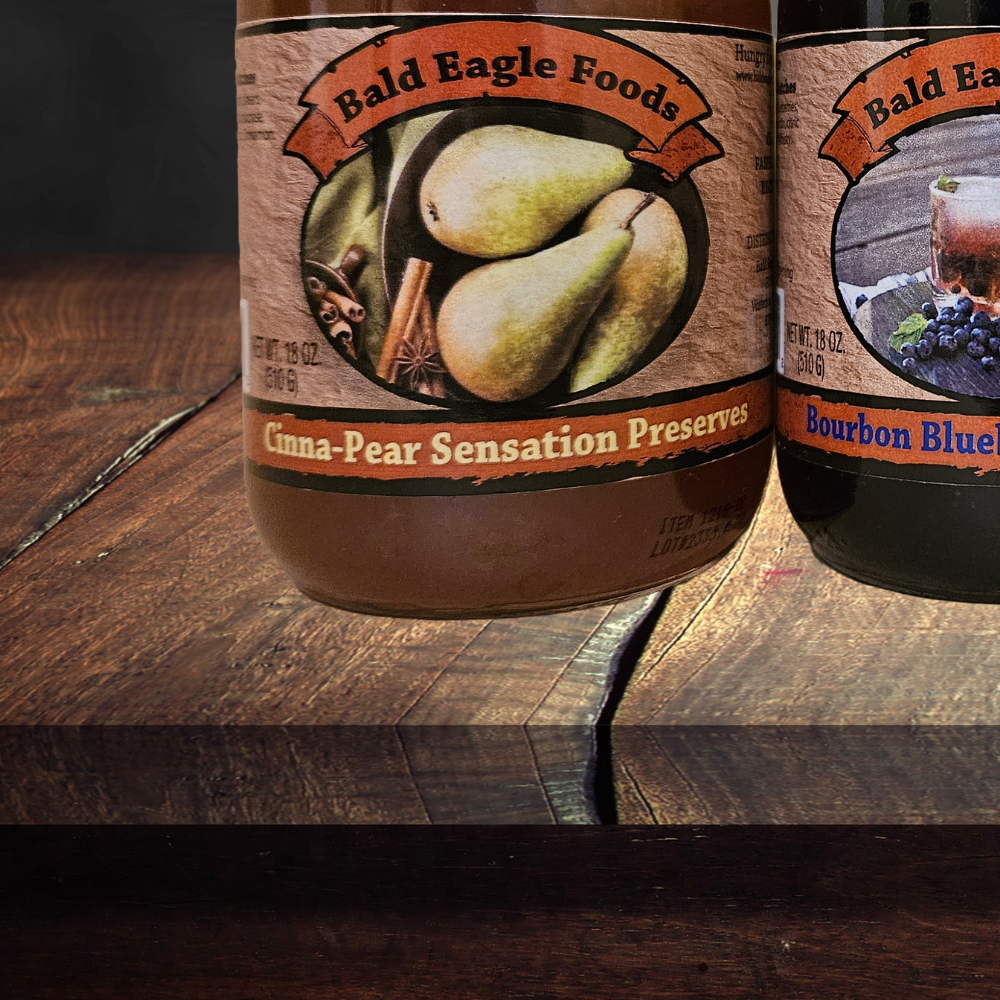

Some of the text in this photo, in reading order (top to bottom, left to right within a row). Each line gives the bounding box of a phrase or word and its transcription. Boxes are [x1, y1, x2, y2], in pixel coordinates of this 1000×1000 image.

[735, 44, 766, 69] Hungry
[334, 46, 681, 124] Bald Eagle Foods
[864, 67, 947, 130] Bald
[799, 326, 813, 349] WT.
[815, 329, 826, 351] 18
[829, 330, 846, 354] OZ.
[797, 350, 825, 381] (510 G)
[264, 401, 749, 466] Cinna-Pear Sensation Preserves
[805, 404, 911, 450] Bourbon
[659, 514, 695, 535] ITEM
